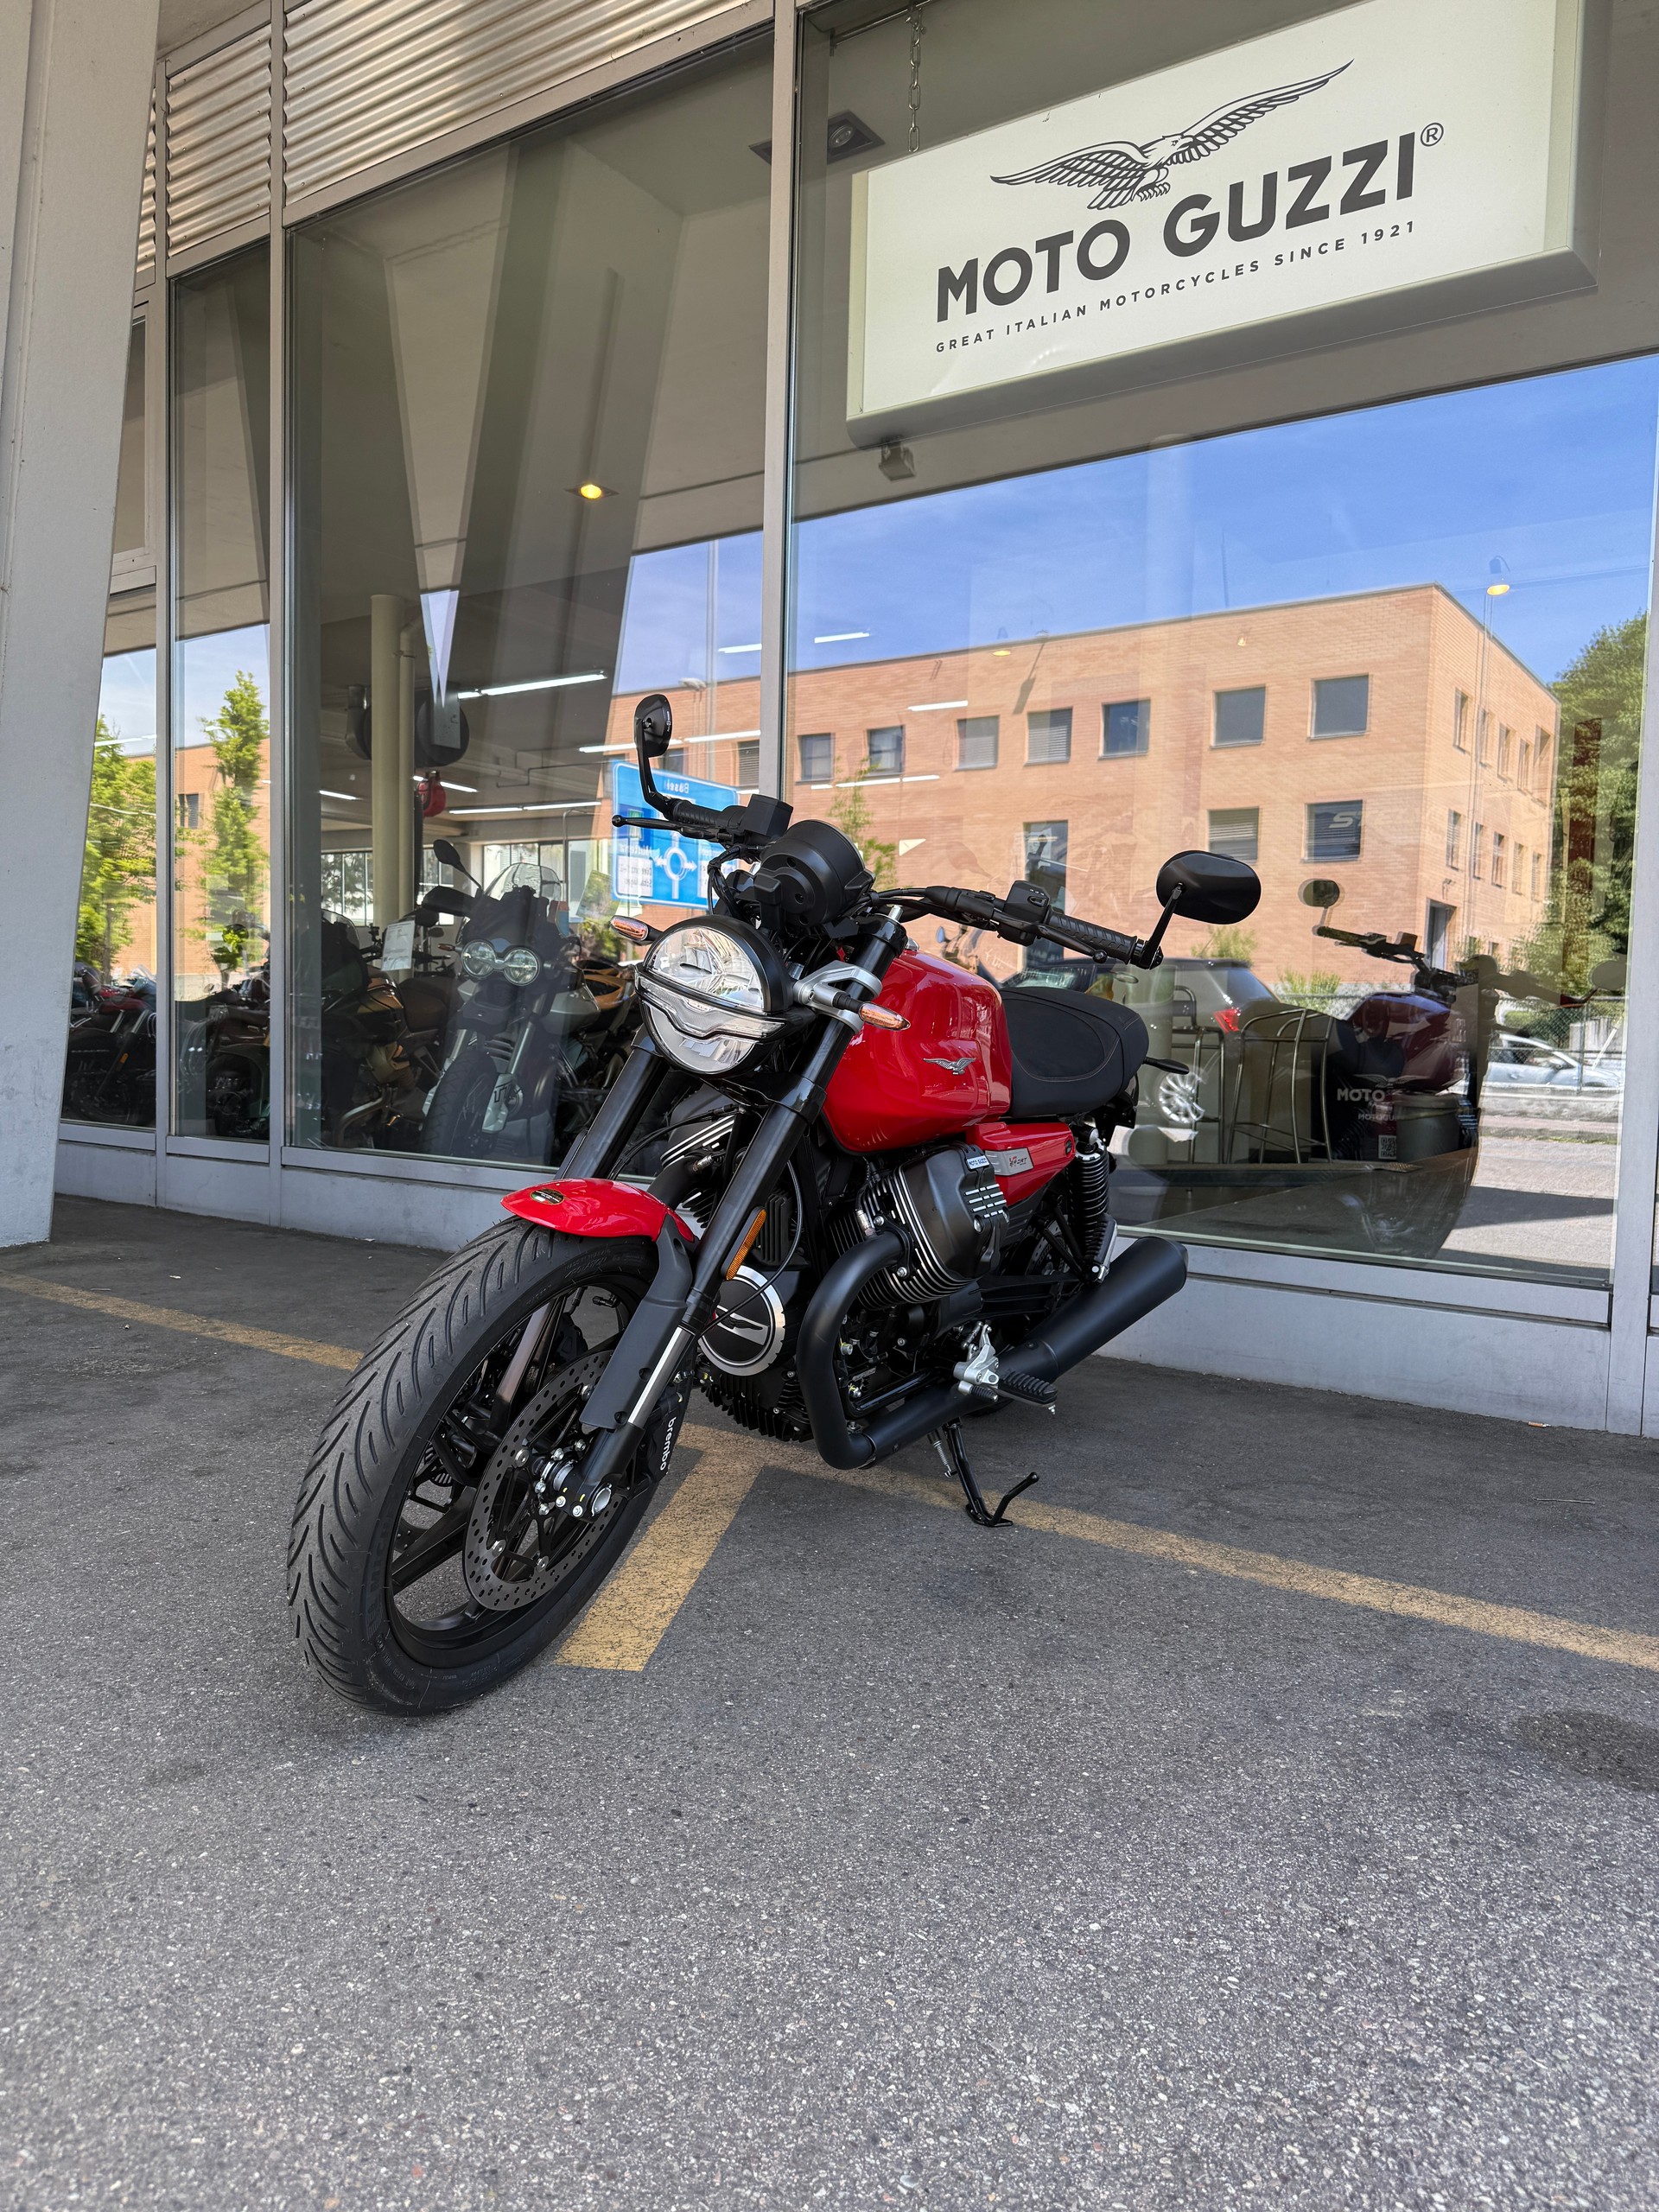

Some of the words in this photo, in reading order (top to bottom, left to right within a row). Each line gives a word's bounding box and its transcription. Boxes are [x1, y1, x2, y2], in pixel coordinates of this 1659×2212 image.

[938, 219, 1130, 322] MOTO
[1164, 132, 1415, 257] GUZZI
[936, 328, 995, 353] GREAT
[1006, 305, 1087, 336] ITALIAN
[1099, 260, 1259, 311] MOTORCYCLES
[1274, 238, 1344, 266] SINCE
[1362, 220, 1414, 245] 1921
[1337, 1088, 1386, 1103] MOTO
[1357, 1113, 1396, 1122] MOTOGU
[659, 1416, 677, 1471] brembo
